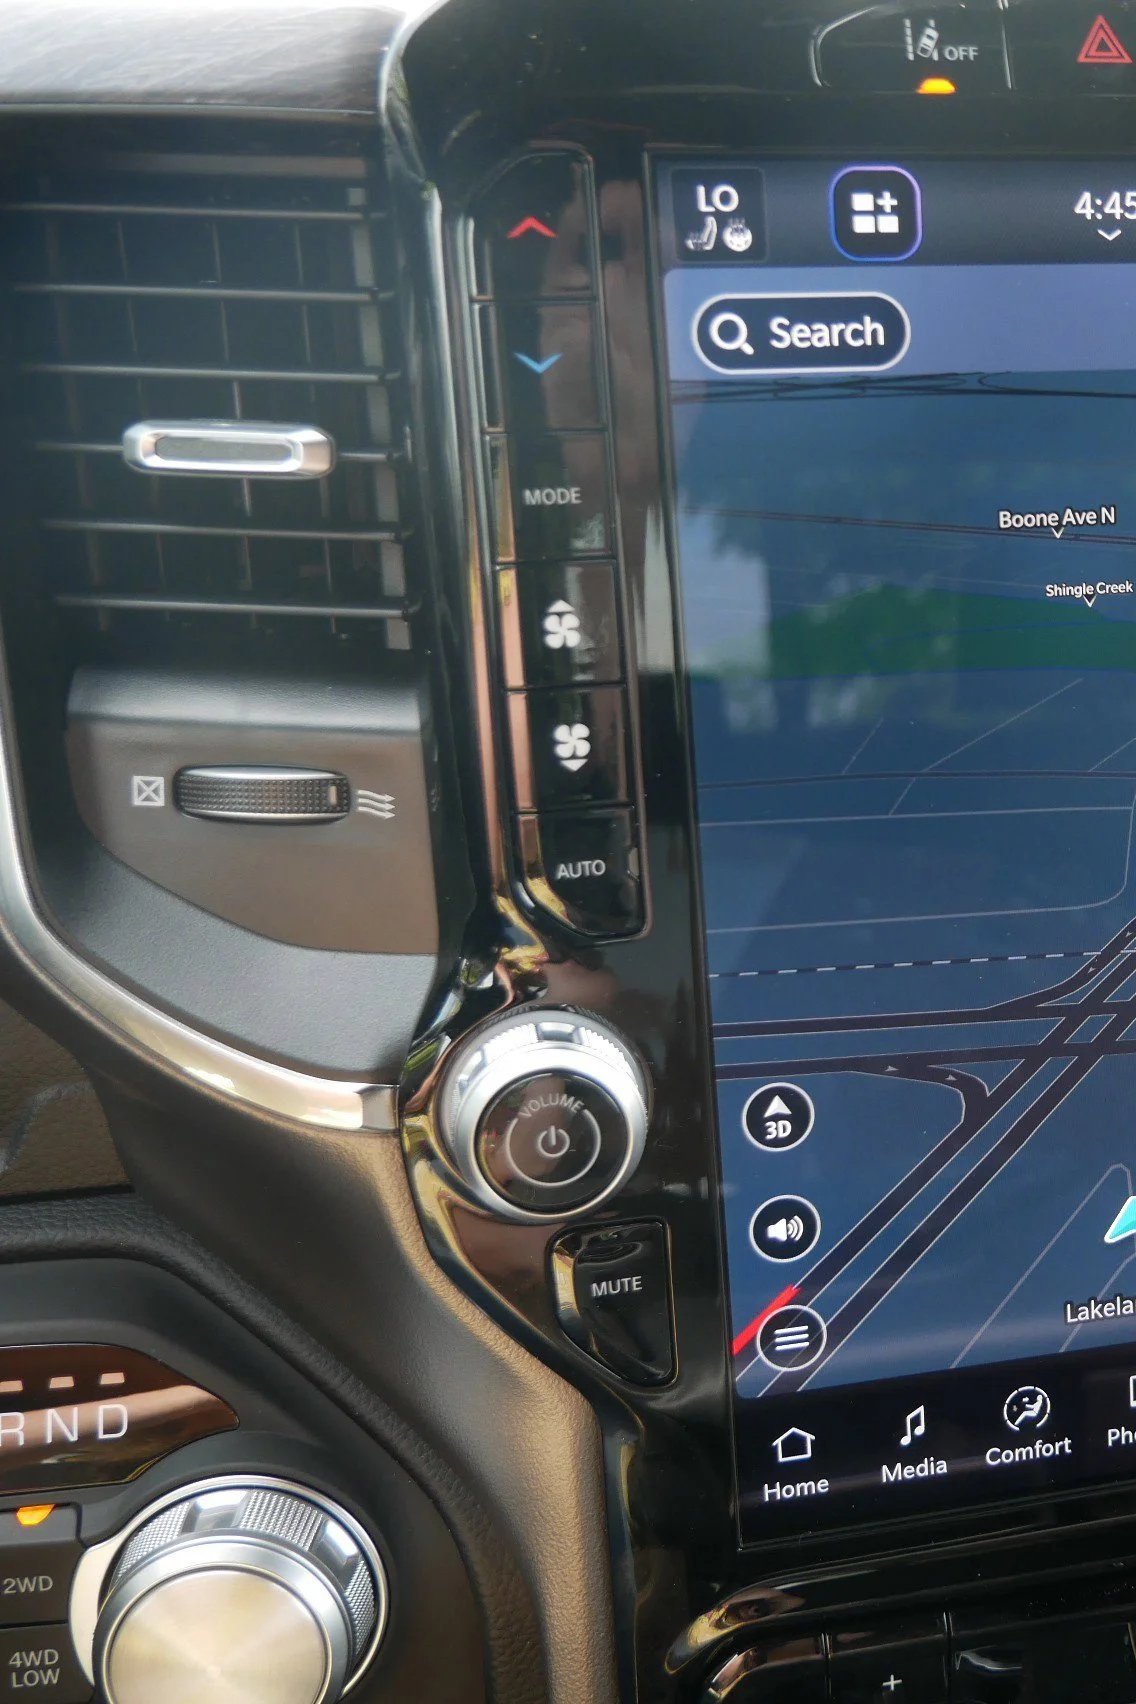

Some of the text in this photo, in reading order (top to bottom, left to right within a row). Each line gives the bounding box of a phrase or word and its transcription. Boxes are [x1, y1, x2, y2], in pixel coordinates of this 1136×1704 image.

[945, 46, 979, 62] OFF
[697, 184, 739, 214] LO
[769, 315, 885, 349] Search
[524, 487, 582, 506] MODE
[999, 507, 1116, 529] Boone Ave N
[1045, 580, 1134, 600] Shingle Creek
[556, 859, 606, 879] AUTO
[518, 1092, 585, 1119] VOLUME
[765, 1119, 792, 1139] 3D
[590, 1275, 643, 1297] MUTE
[0, 1403, 129, 1447] R N D
[985, 1436, 1072, 1466] Comfort
[881, 1456, 948, 1483] Media
[764, 1475, 830, 1502] Home
[3, 1575, 54, 1594] 2WD
[8, 1648, 59, 1668] 4WD
[11, 1668, 61, 1689] LOW
